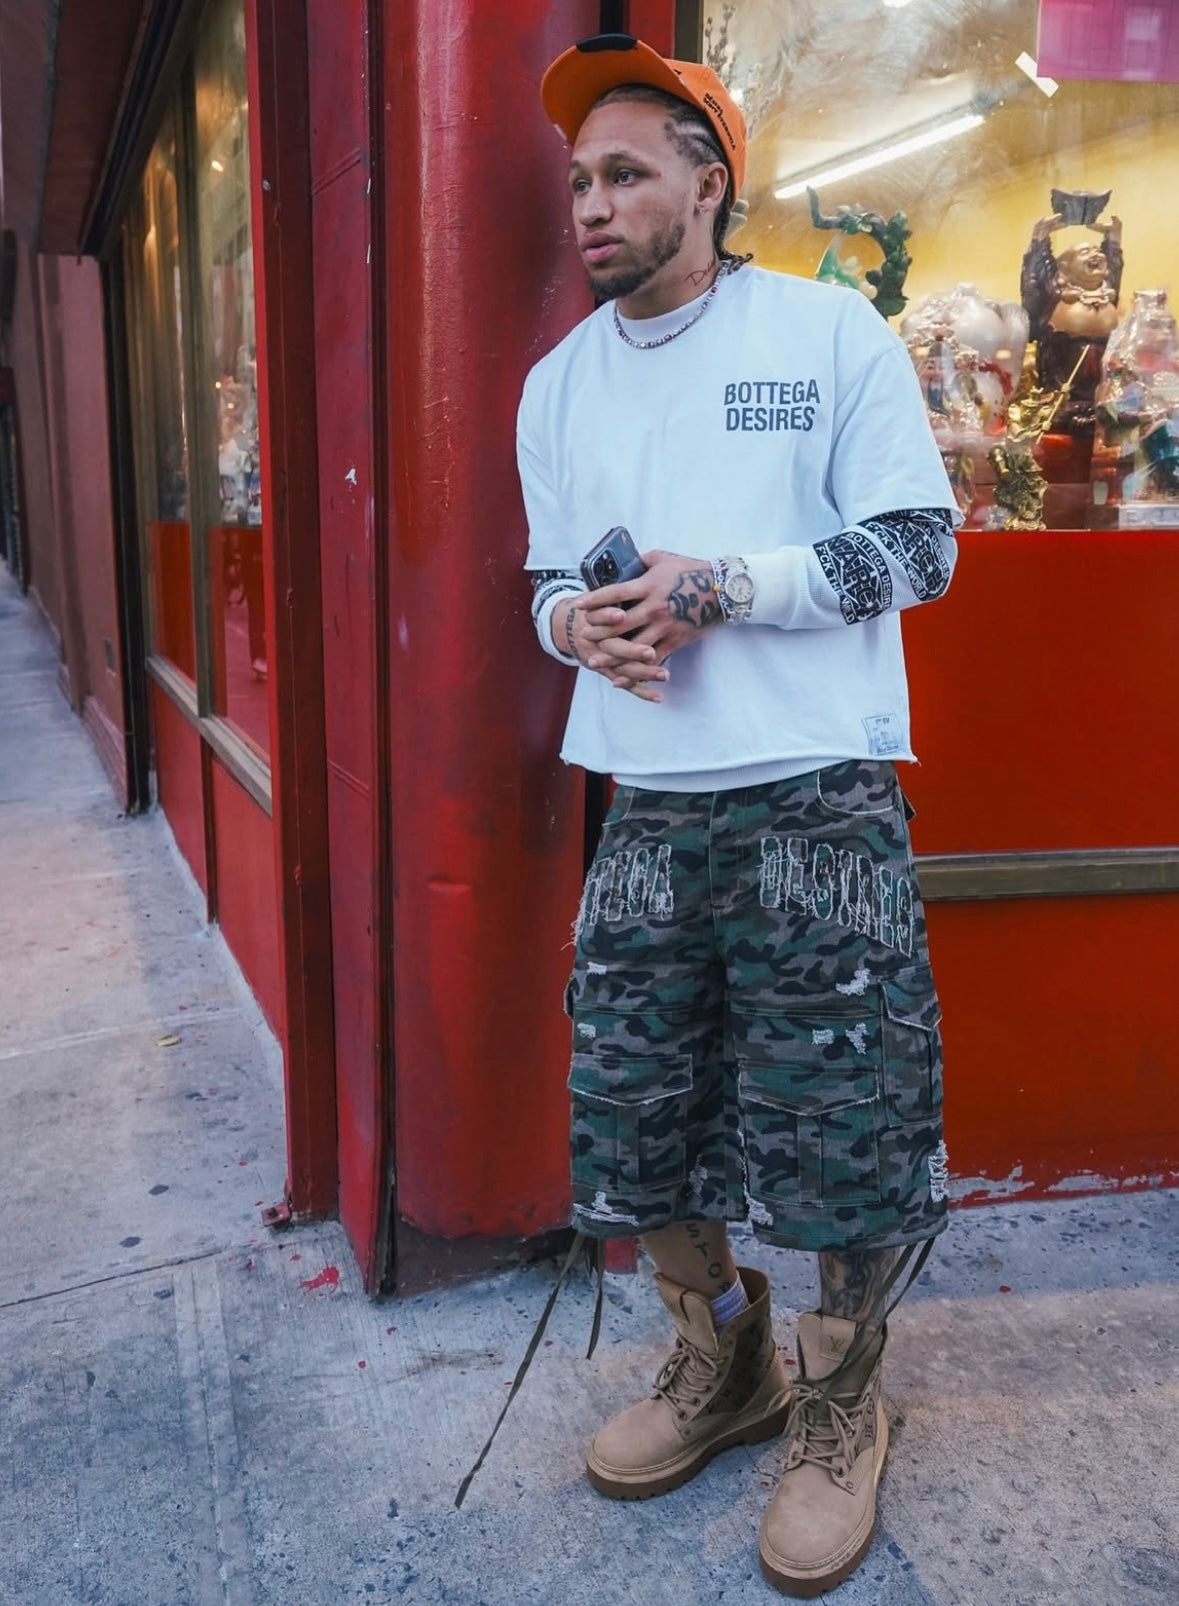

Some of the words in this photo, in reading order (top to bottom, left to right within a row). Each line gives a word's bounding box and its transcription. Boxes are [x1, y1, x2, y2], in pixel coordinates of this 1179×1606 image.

[724, 379, 820, 405] BOTTEGA
[726, 406, 815, 431] DESIRES
[890, 543, 907, 566] THE
[907, 566, 927, 599] WORLD
[828, 573, 844, 597] THE
